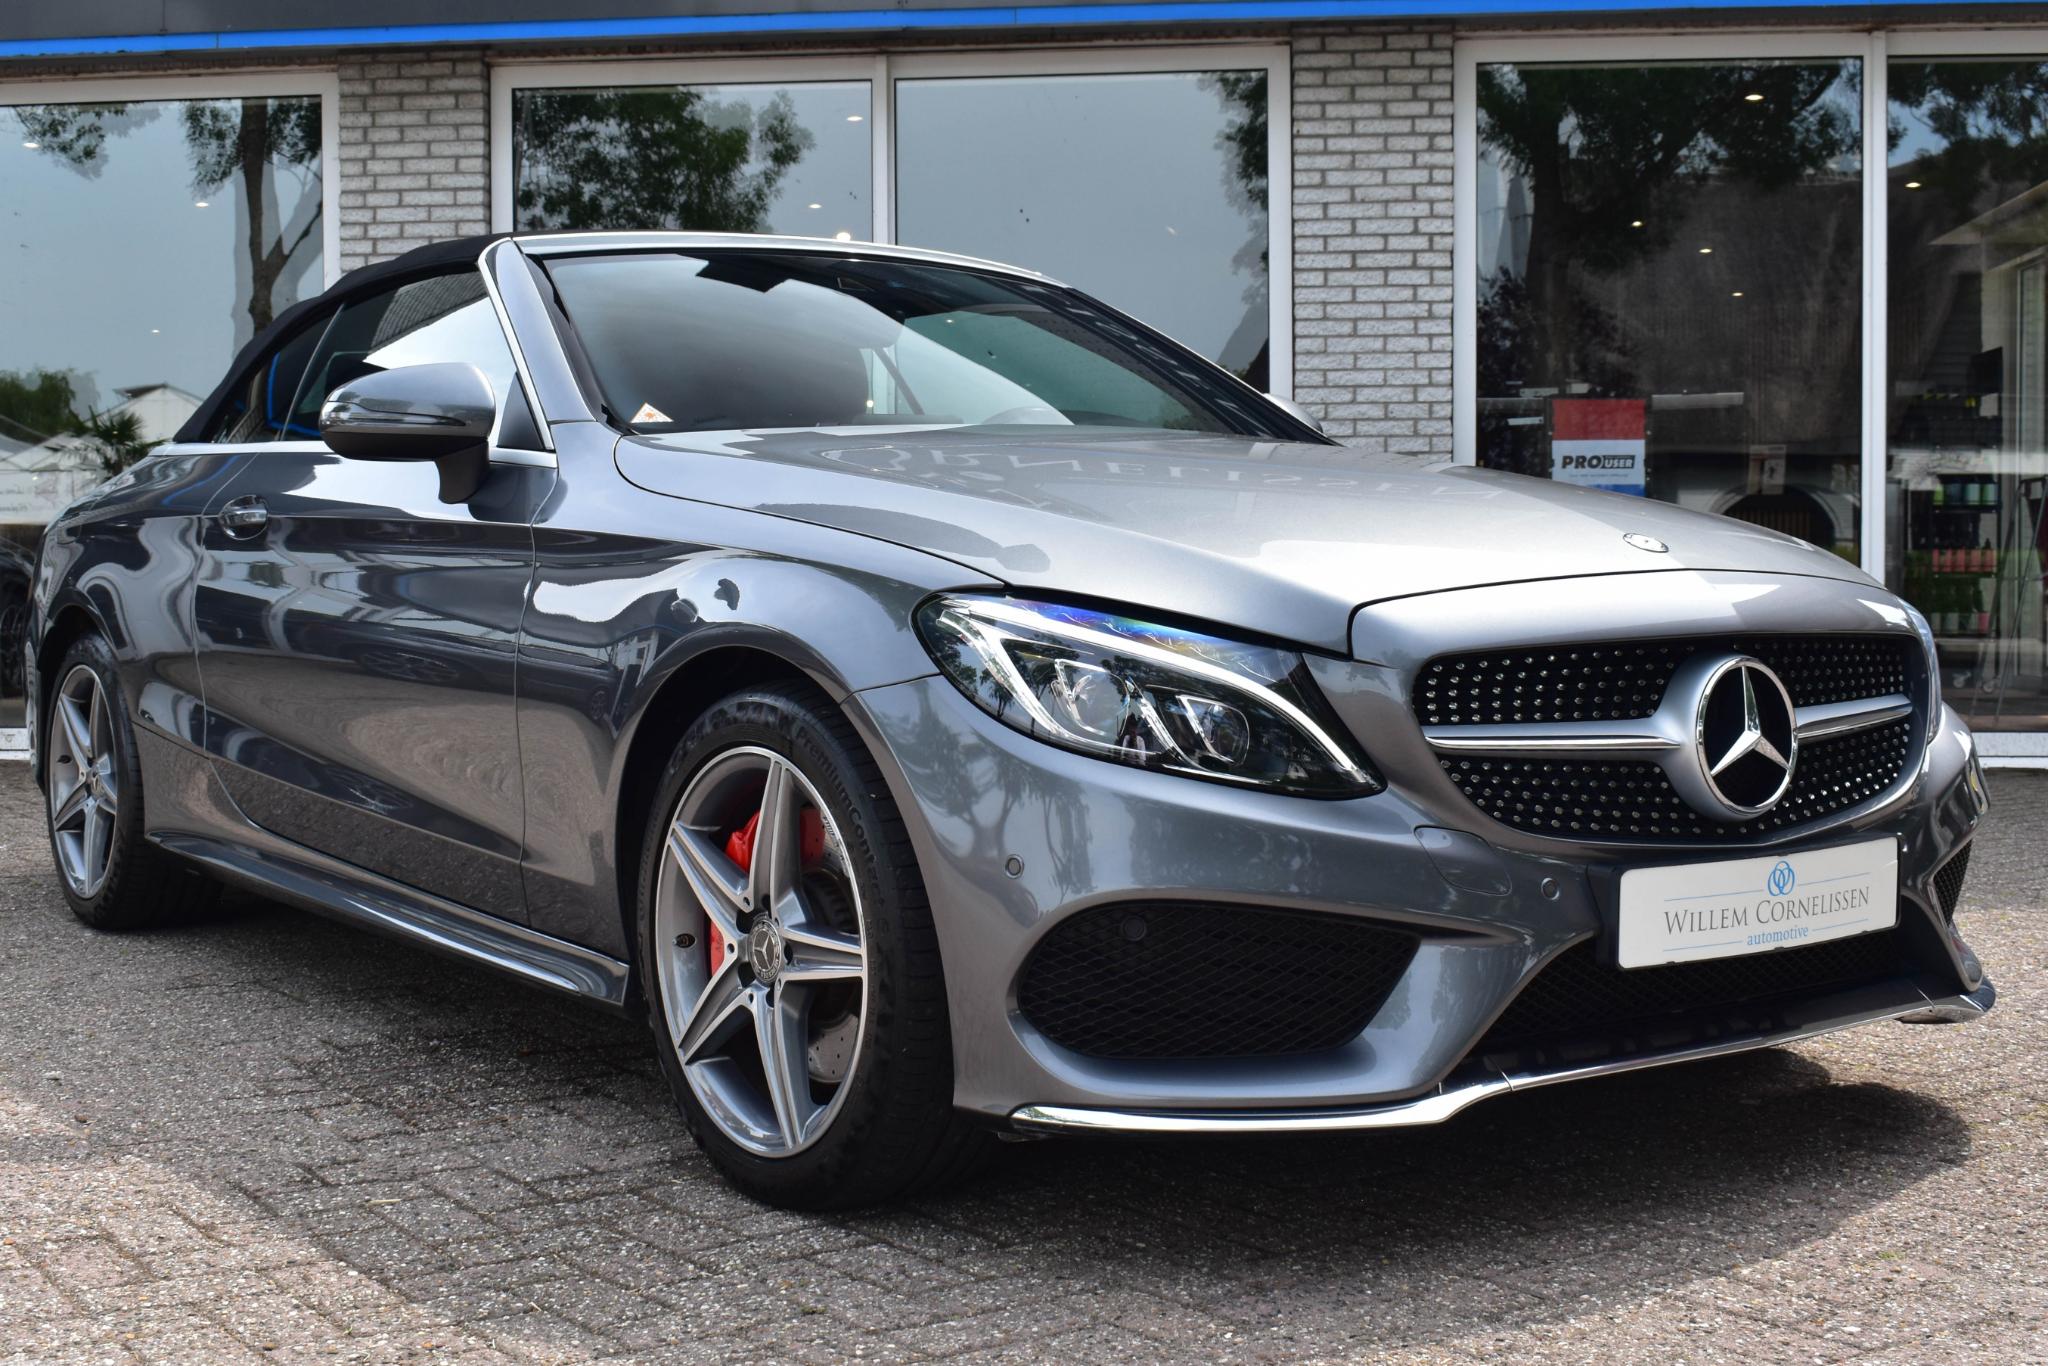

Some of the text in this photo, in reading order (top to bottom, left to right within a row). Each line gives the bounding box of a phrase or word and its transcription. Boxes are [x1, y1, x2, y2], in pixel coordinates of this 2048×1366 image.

[1561, 455, 1633, 469] PRO USER
[1664, 886, 1870, 935] WILLEM CORNELISSEN
[1747, 925, 1809, 946] automotive
